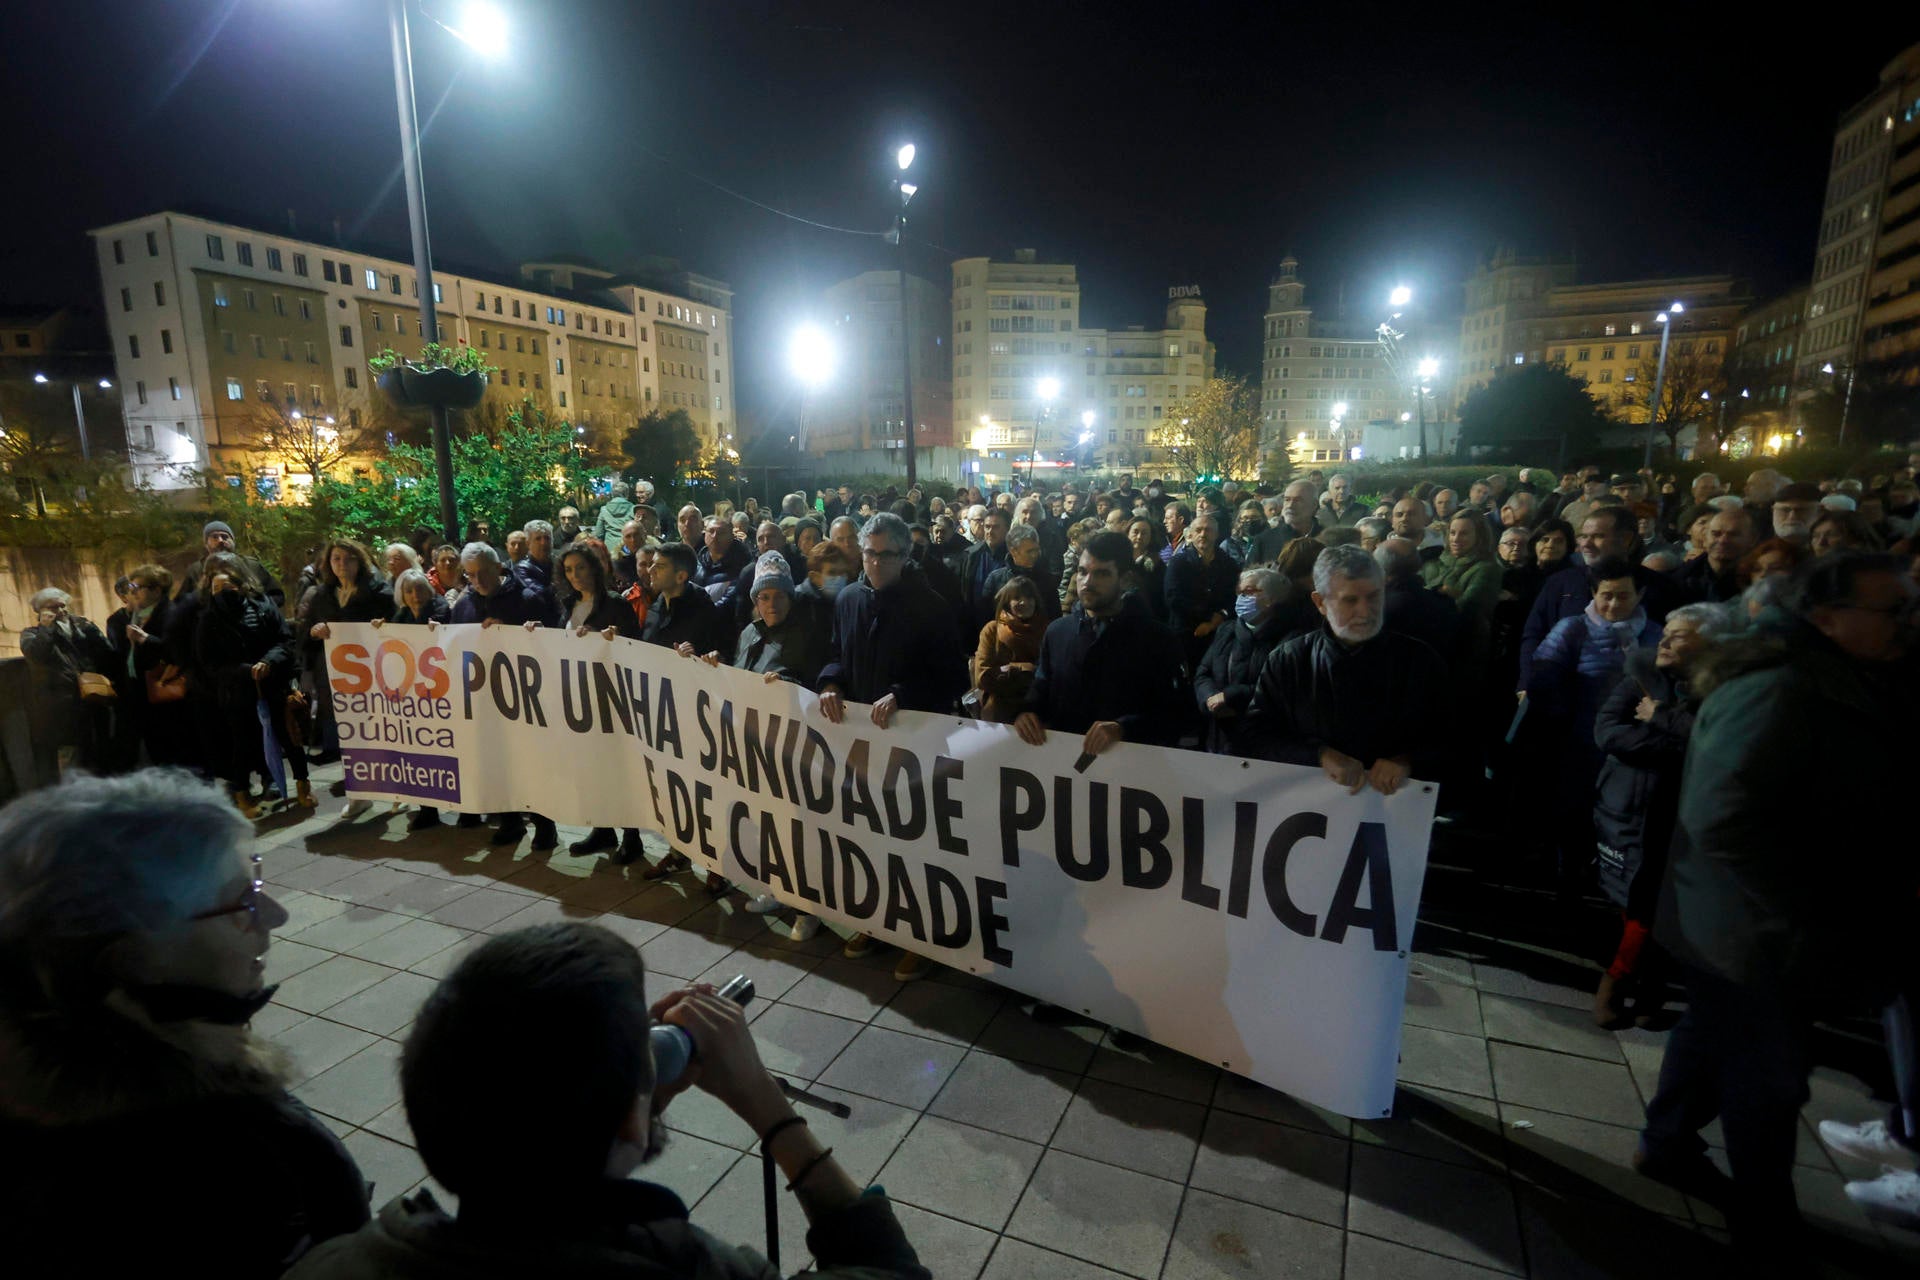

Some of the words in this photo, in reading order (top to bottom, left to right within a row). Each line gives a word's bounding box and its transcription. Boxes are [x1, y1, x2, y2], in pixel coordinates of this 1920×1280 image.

[1169, 285, 1201, 298] BBVA
[330, 639, 451, 703] SOS
[333, 686, 452, 720] sanidade
[341, 755, 457, 791] Ferrolterra
[462, 650, 548, 728] POR
[560, 658, 683, 760] UNHA
[696, 688, 970, 857] SANIDADE
[1000, 751, 1399, 952] PÚBLICA
[643, 754, 666, 828] E
[666, 769, 718, 860] DE
[729, 801, 1014, 969] CALIDADE
